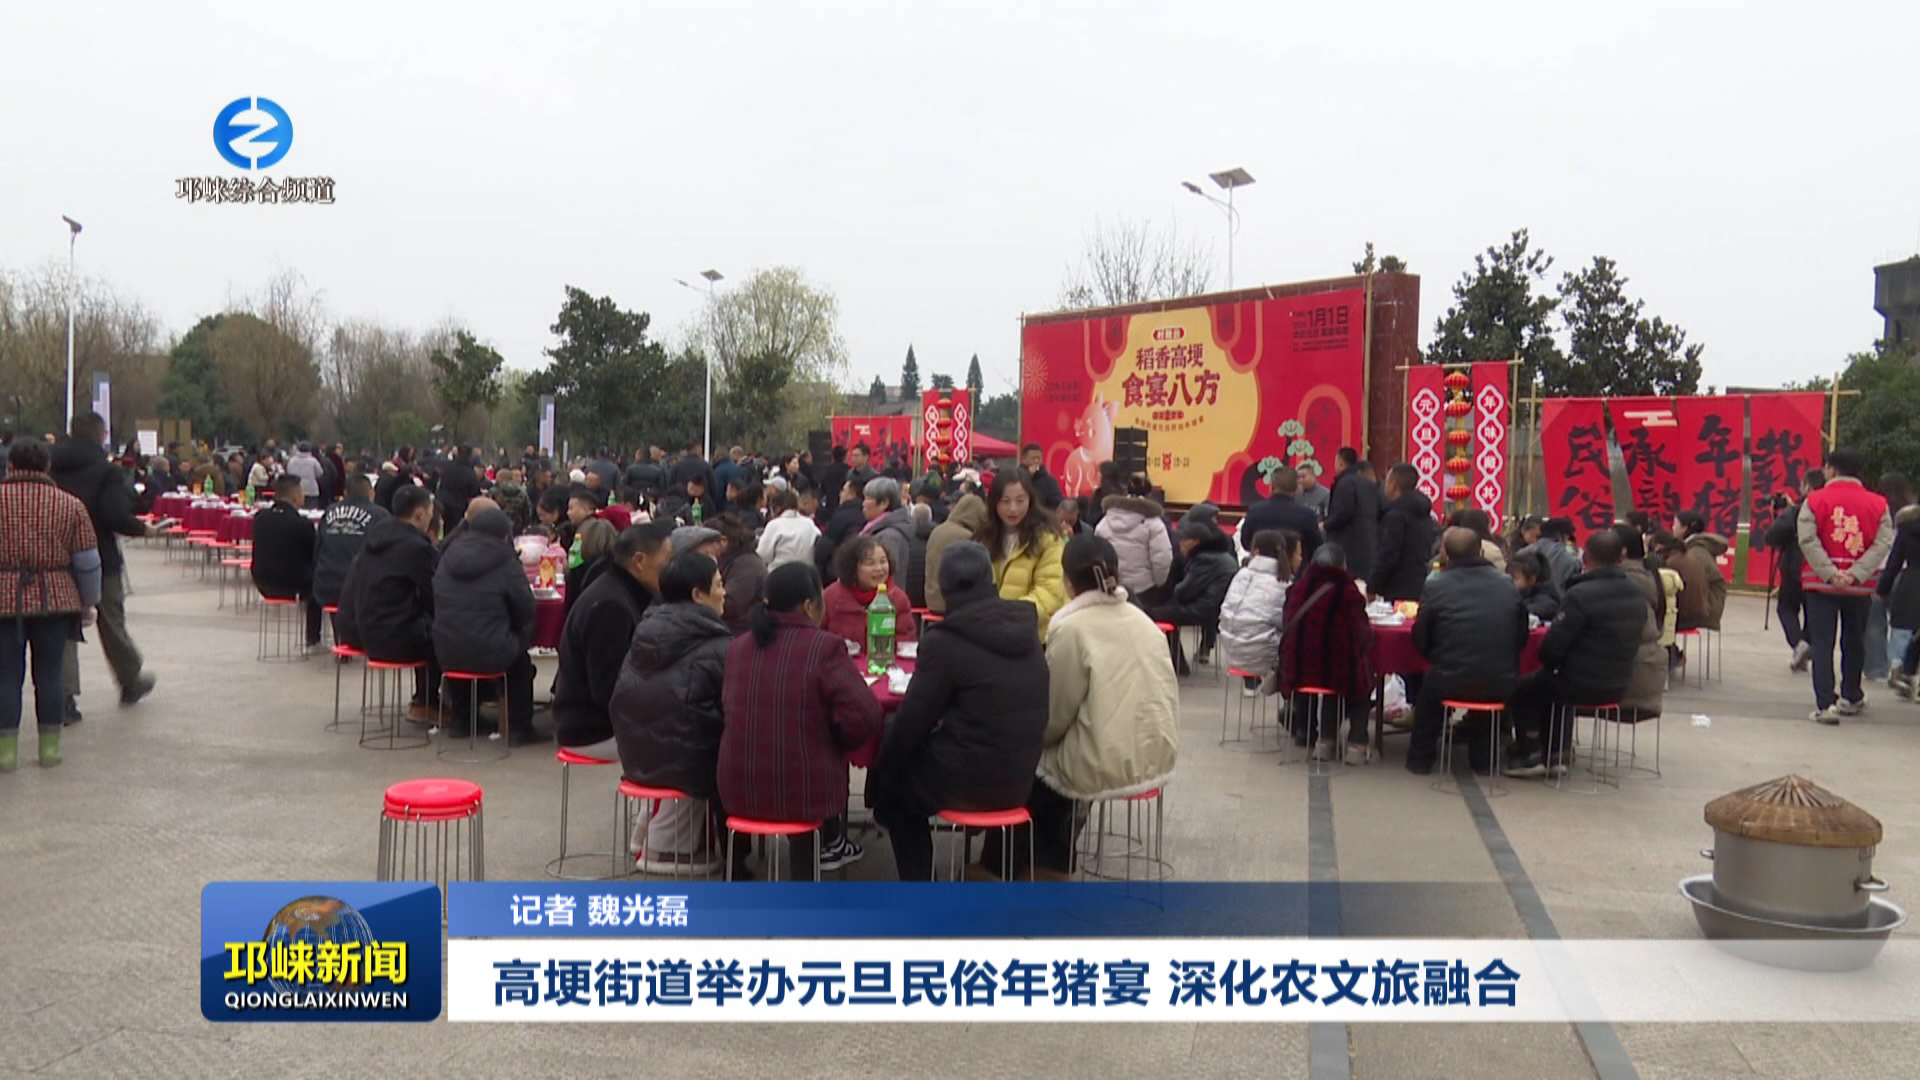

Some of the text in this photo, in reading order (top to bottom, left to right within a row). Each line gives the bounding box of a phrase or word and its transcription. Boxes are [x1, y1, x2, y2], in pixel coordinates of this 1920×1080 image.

[1122, 369, 1220, 408] 食宴八方
[1136, 343, 1204, 370] 稻香高埂
[1559, 421, 1614, 531] 民俗
[1692, 414, 1741, 538] 年猪
